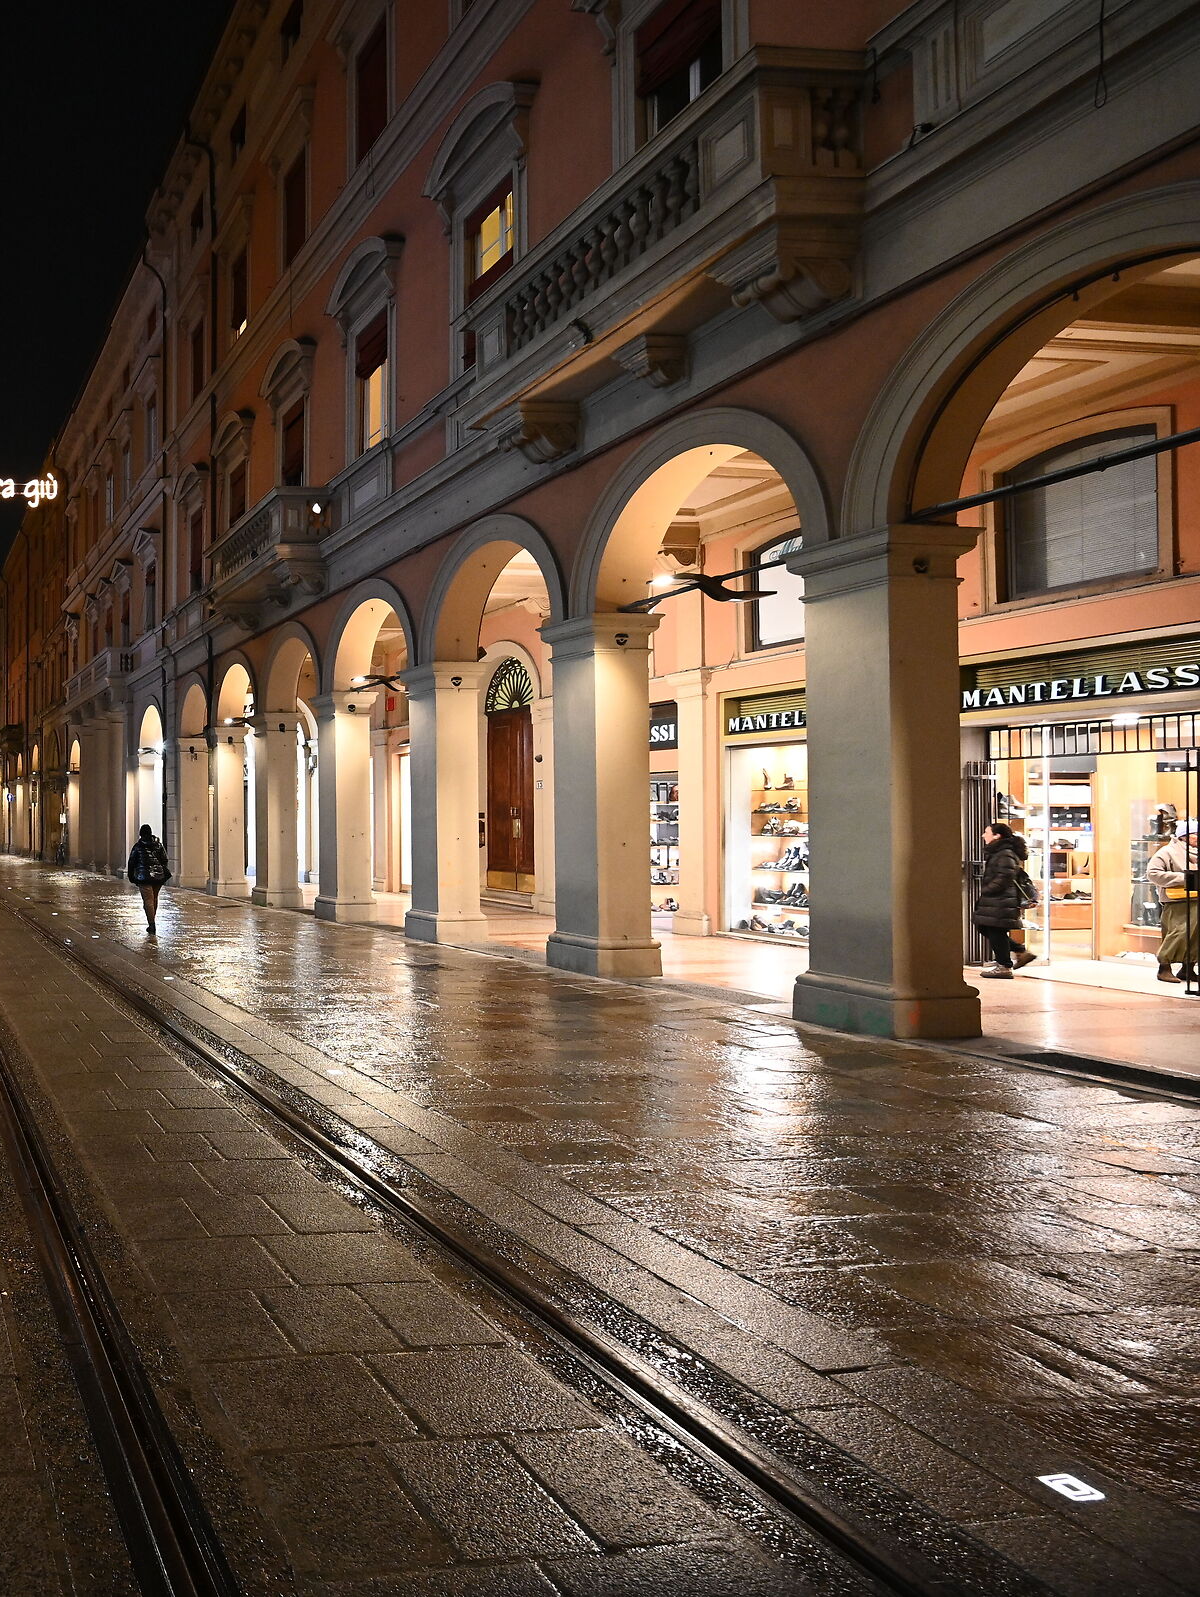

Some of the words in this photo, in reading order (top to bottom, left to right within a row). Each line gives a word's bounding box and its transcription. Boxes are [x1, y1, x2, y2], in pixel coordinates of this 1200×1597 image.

[24, 472, 58, 508] giù
[962, 664, 1200, 709] MANTELLASS
[649, 724, 676, 743] SSI
